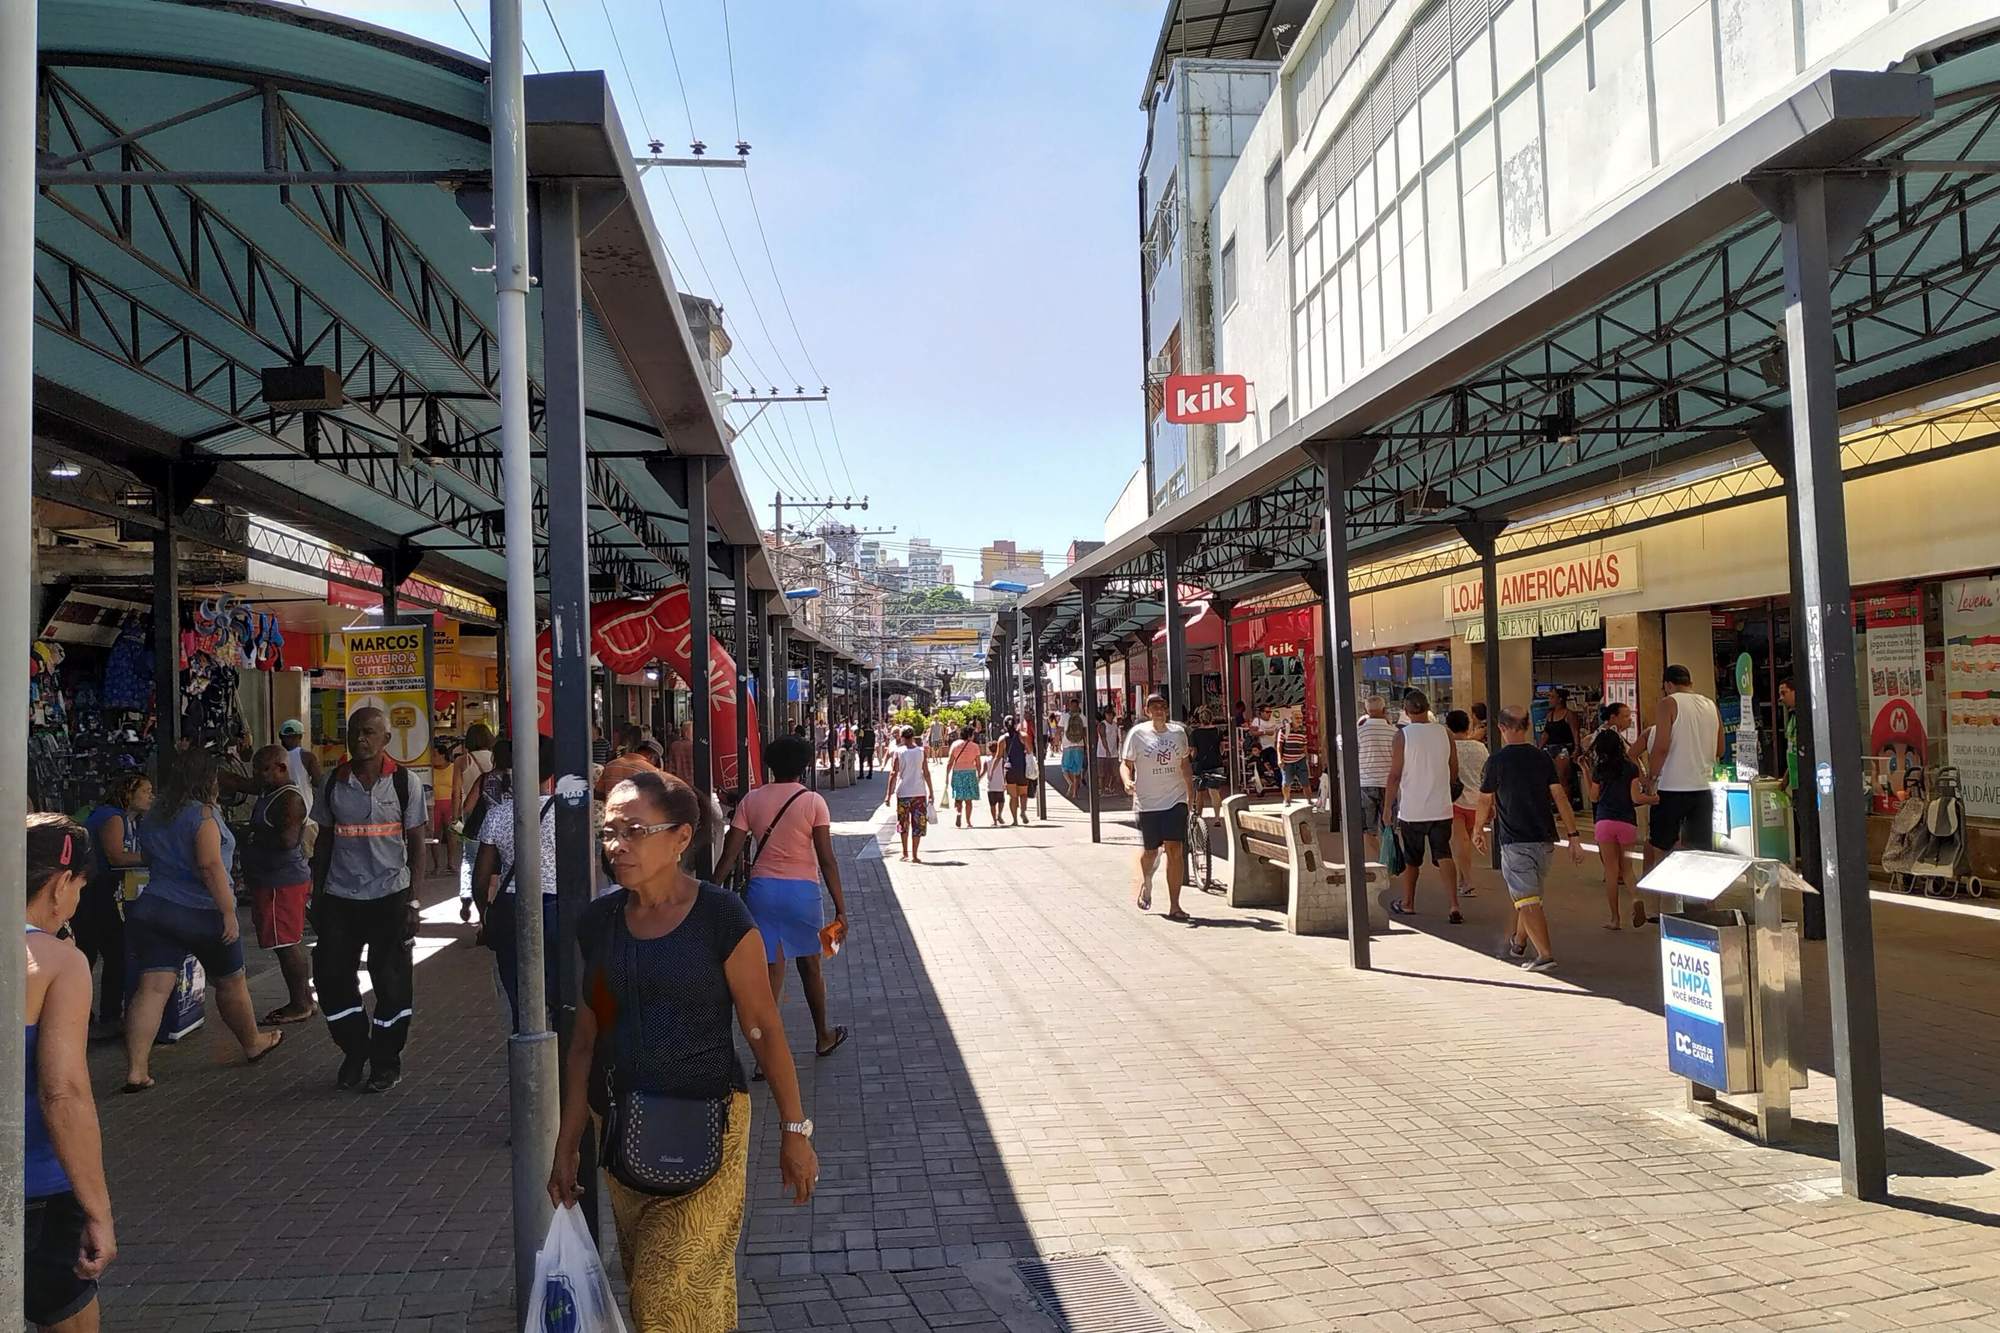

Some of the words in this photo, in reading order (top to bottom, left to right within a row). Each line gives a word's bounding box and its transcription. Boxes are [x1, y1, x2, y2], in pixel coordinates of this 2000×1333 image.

[1177, 382, 1236, 416] kik
[1453, 582, 1484, 613] LOJA
[1501, 554, 1620, 606] AMERICANAS
[1543, 612, 1576, 633] MOTO
[1581, 609, 1598, 628] G7
[351, 635, 419, 652] MARCOS
[1269, 643, 1294, 656] kik
[353, 652, 407, 666] CHAVEIRO
[409, 652, 417, 662] &
[356, 664, 415, 676] CUTELARIA
[1741, 667, 1750, 689] oi
[1669, 951, 1710, 977] CAXIAS
[1671, 968, 1712, 998] LIMPA
[1672, 989, 1687, 1002] VOCÊ
[1688, 996, 1713, 1010] MERECE
[1675, 1031, 1692, 1056] DC
